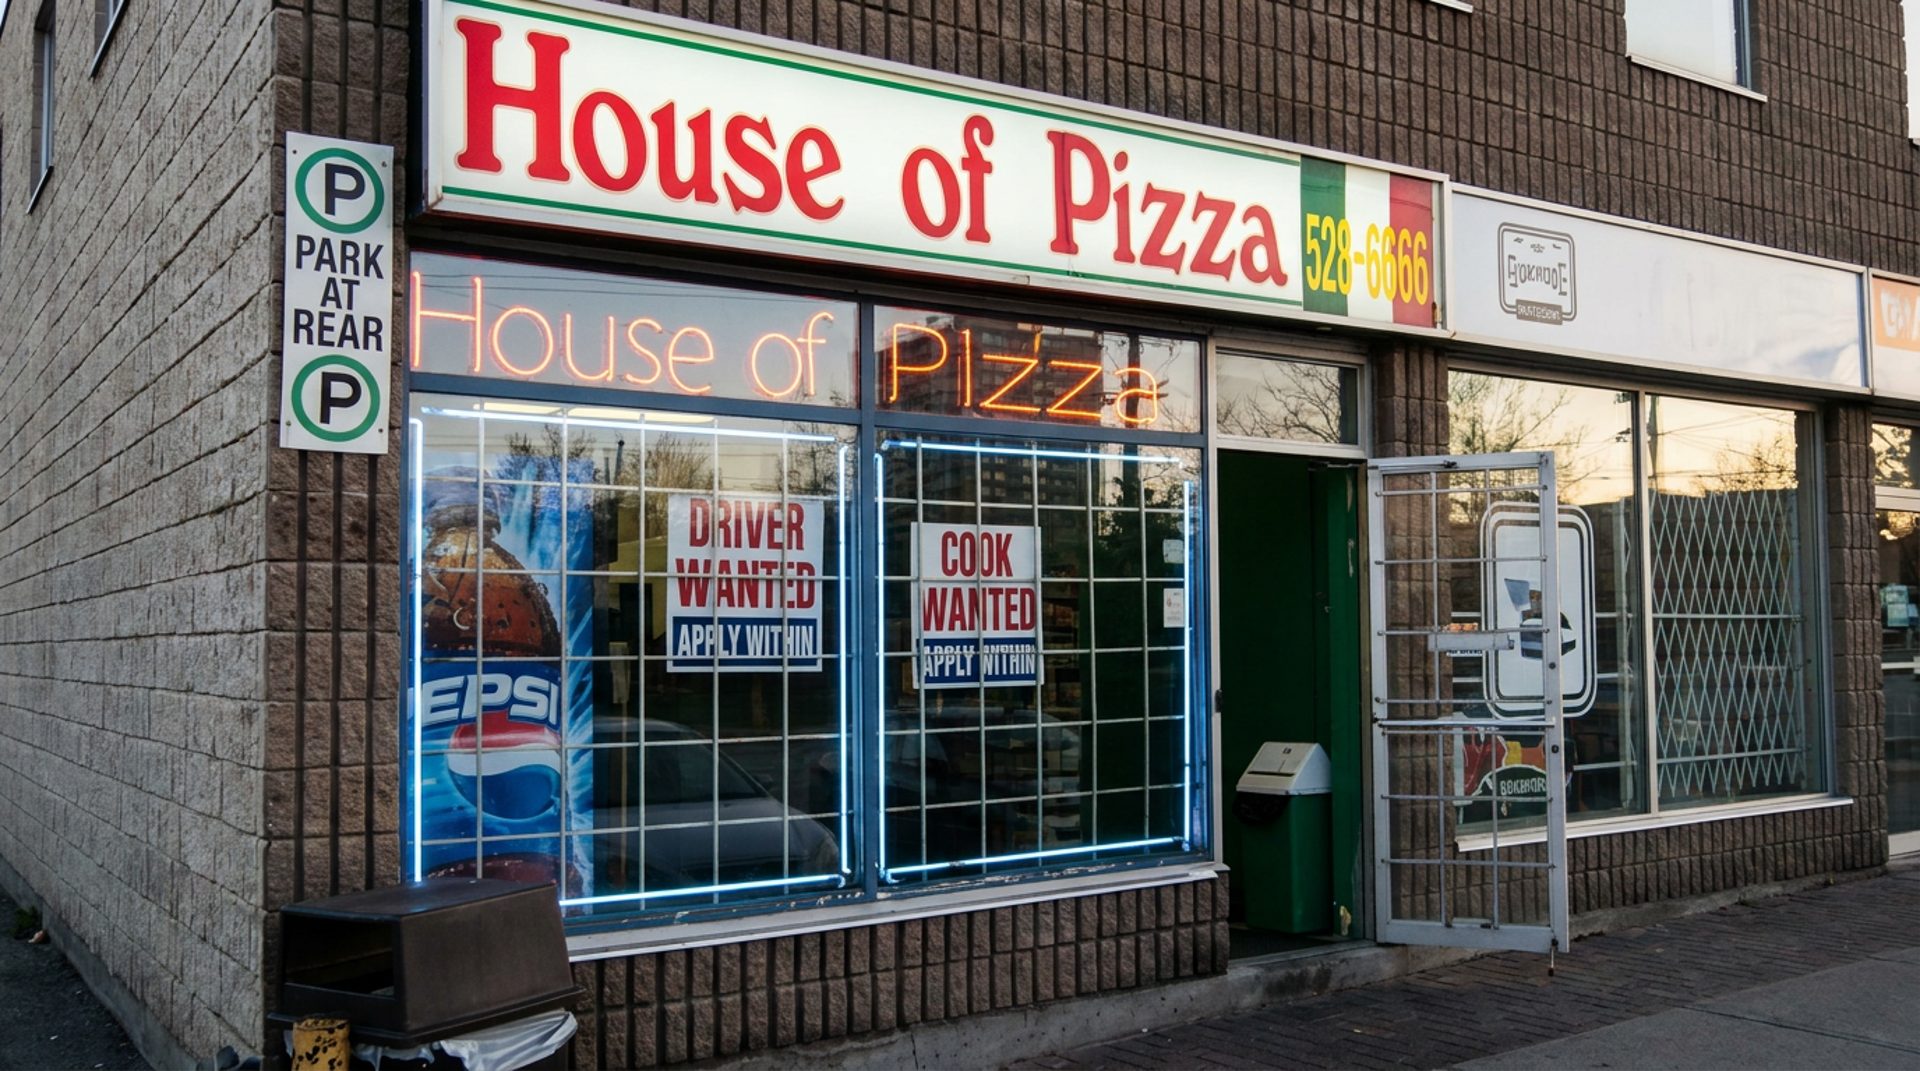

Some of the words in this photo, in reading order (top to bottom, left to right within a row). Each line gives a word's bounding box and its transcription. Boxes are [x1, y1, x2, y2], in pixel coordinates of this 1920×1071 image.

[455, 18, 845, 220] House
[901, 114, 995, 243] of
[1047, 129, 1290, 288] Pizza
[295, 234, 384, 279] PARK
[1304, 213, 1430, 306] 528-6666
[320, 277, 360, 311] AT
[293, 308, 383, 352] REAR
[410, 271, 716, 394] House
[752, 311, 836, 399] of
[689, 498, 804, 549] DRIVER
[941, 531, 1013, 577] COOK
[676, 558, 816, 609] WANTED
[922, 587, 1036, 632] WANTED
[678, 624, 742, 657] APPLY
[747, 624, 815, 657] WITHIN
[407, 674, 560, 727] EPSI
